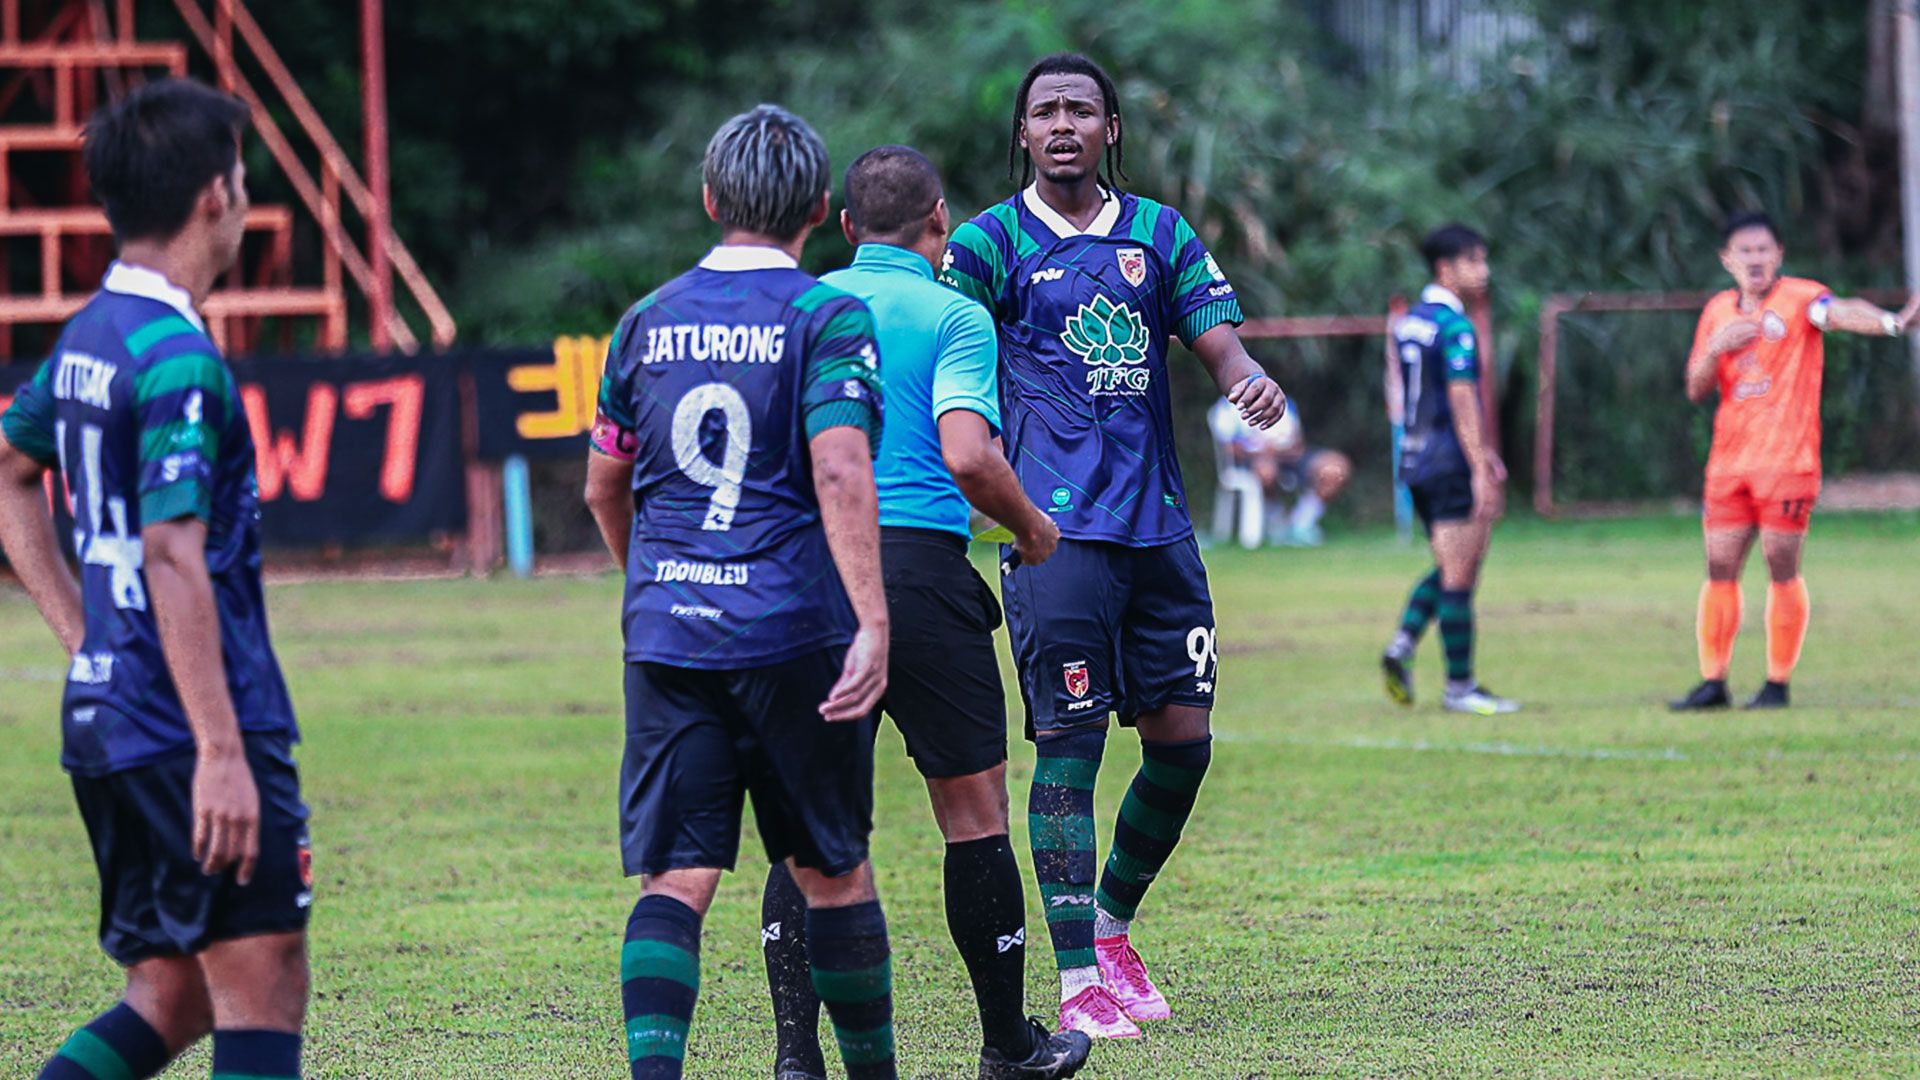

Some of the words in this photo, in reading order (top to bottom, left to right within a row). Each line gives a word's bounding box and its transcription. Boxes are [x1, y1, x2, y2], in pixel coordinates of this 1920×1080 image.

[643, 325, 785, 364] JATURONG
[1086, 367, 1150, 395] TFG
[671, 382, 752, 532] 9
